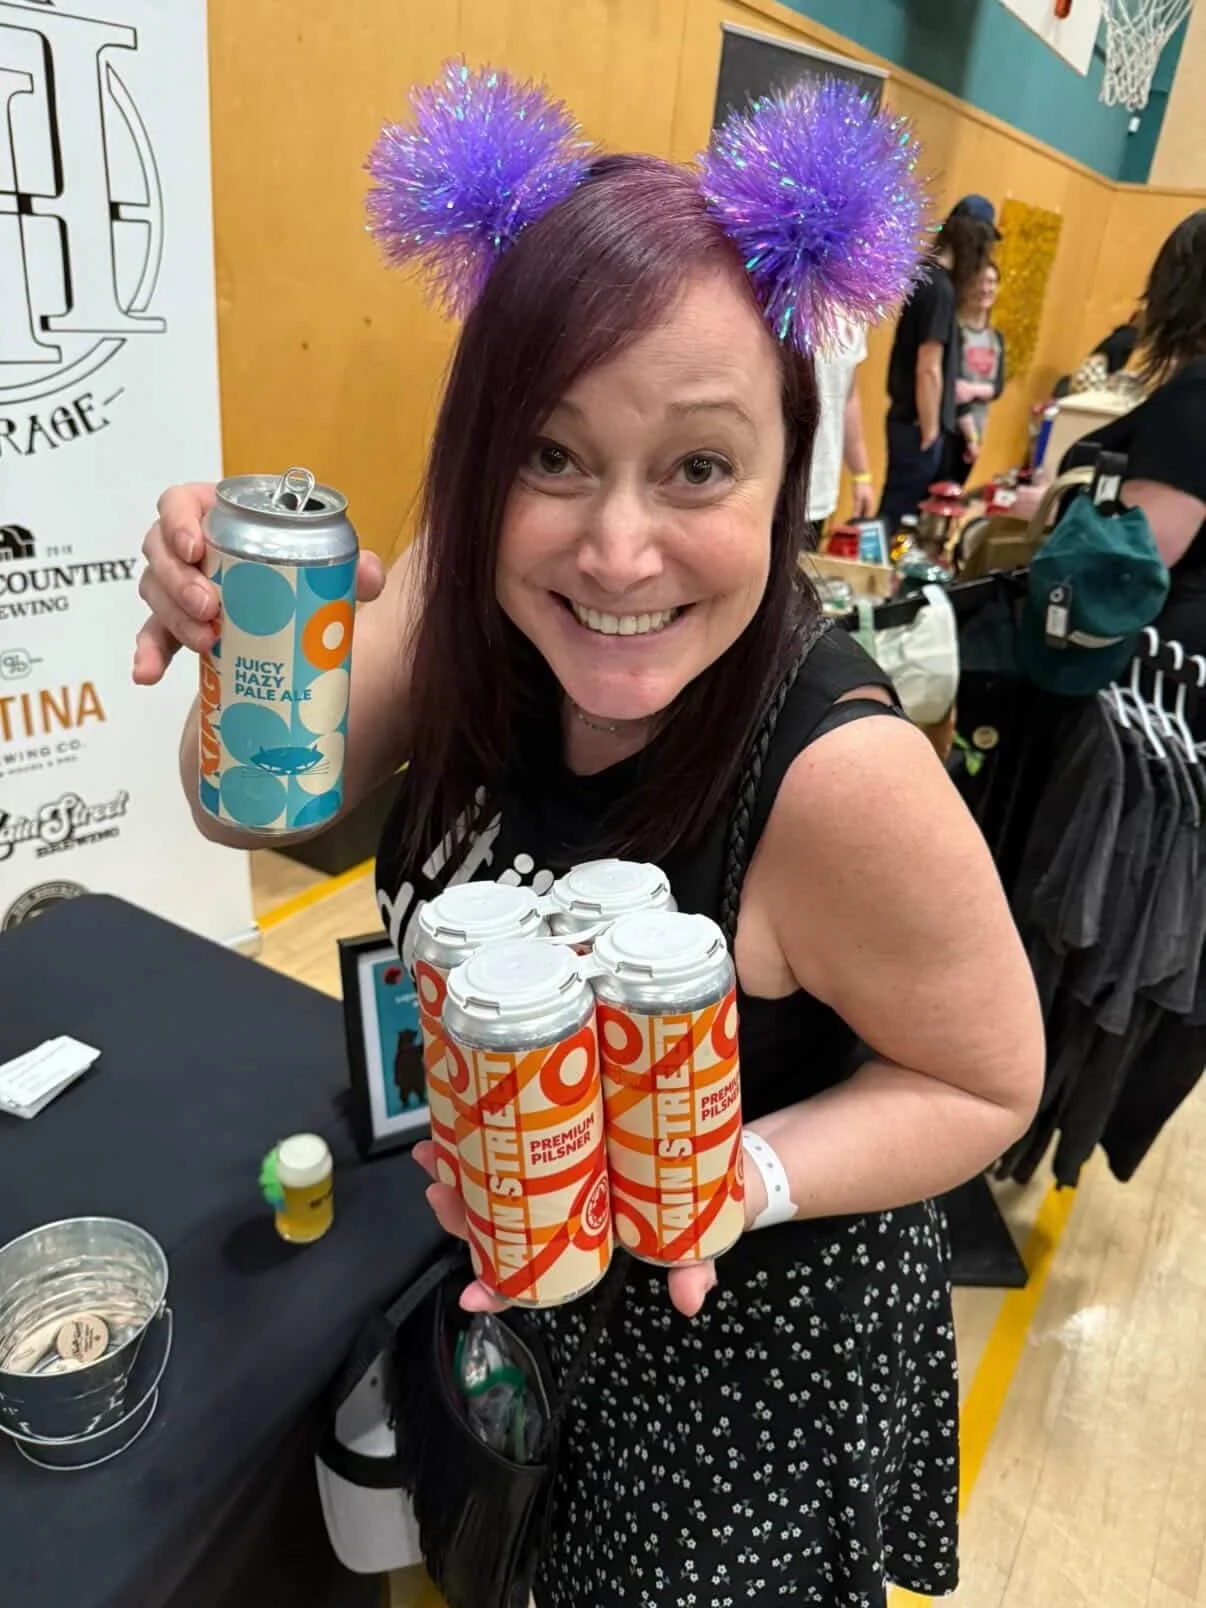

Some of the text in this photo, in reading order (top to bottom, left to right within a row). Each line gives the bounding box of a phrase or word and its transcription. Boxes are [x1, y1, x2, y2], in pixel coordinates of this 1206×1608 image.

[235, 656, 284, 676] JUICY
[235, 670, 284, 689] HAZY
[235, 682, 312, 702] PALE ALE
[530, 1112, 596, 1153] PREMIUM
[531, 1131, 592, 1165] PILSNER
